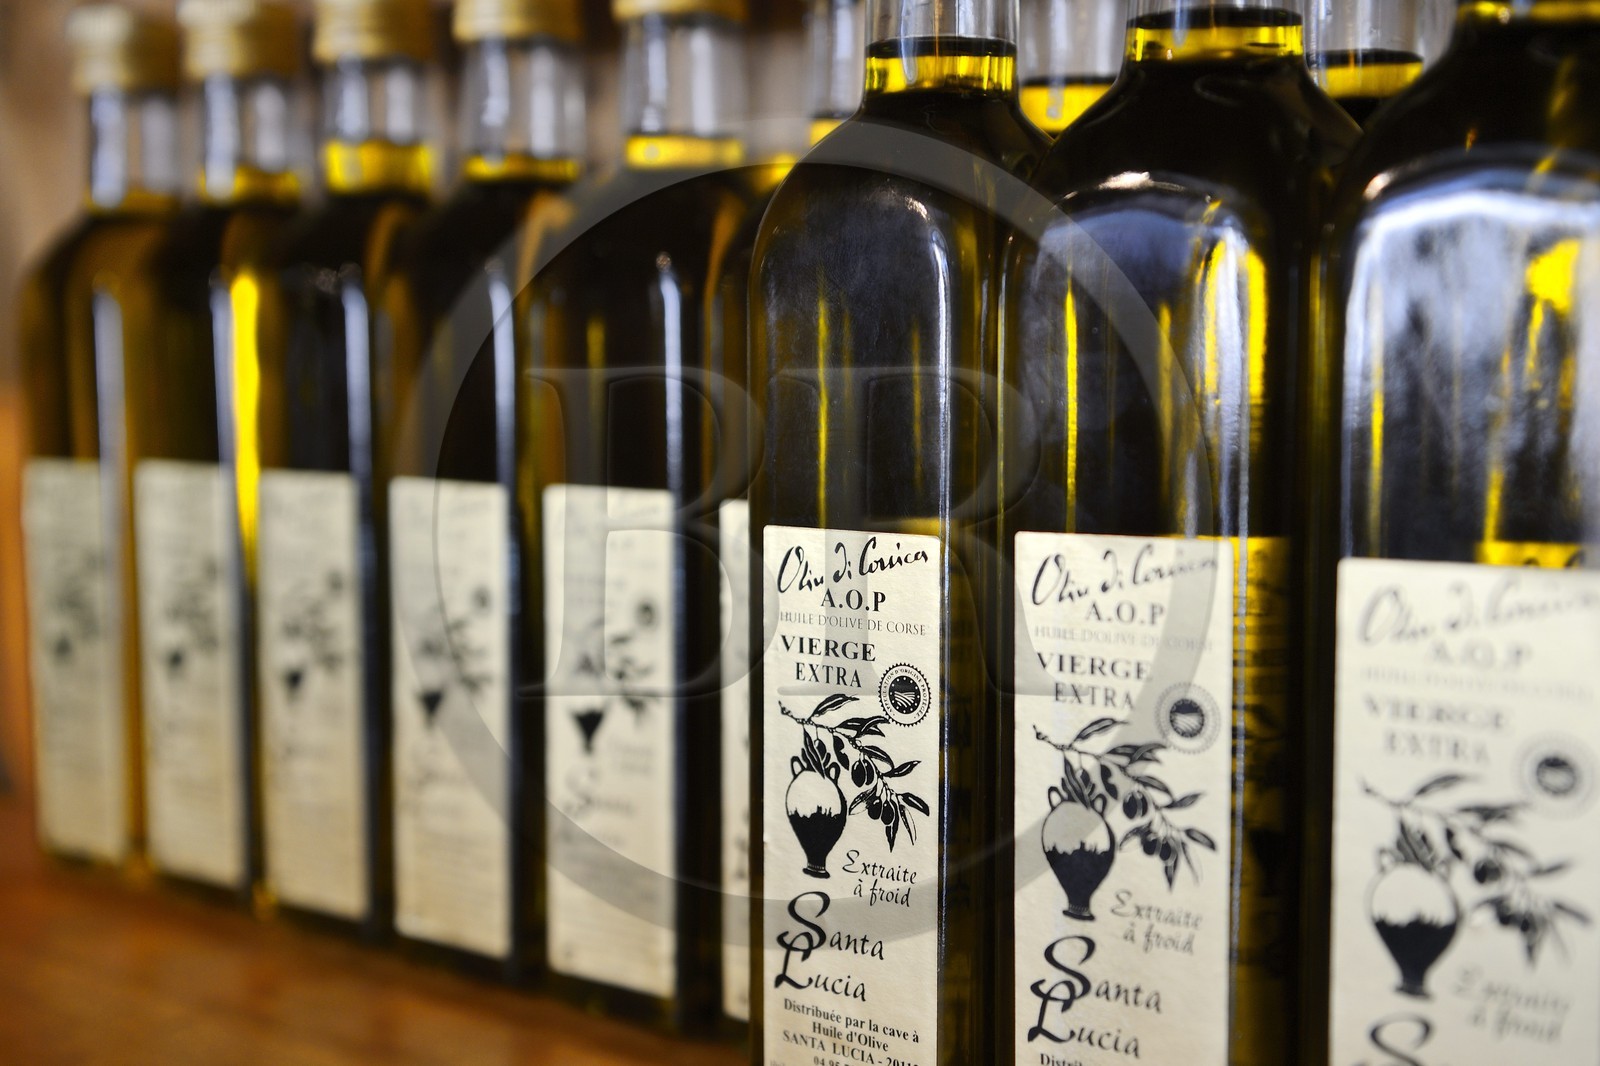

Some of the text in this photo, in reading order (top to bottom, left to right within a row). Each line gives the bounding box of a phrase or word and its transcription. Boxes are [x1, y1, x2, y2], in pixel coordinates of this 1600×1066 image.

[833, 542, 852, 583] di
[859, 536, 928, 576] Corsica
[1101, 550, 1123, 593] di
[820, 588, 886, 612] A.O.P
[1086, 600, 1165, 626] A.O.P
[780, 611, 926, 636] HUILE D'OLIVE DE CORSE
[781, 634, 876, 662] VIERGE
[795, 662, 862, 688] EXTRA
[1037, 652, 1152, 681] VIERGE
[1054, 682, 1135, 710] EXTRA
[842, 849, 917, 884] Extraite
[853, 878, 911, 907] à froid
[777, 891, 884, 960] Santa
[1110, 889, 1202, 931] Extraite
[1144, 924, 1195, 955] froid
[774, 931, 866, 1002] Lucia
[1030, 936, 1162, 1013] Santa
[784, 998, 920, 1043] Distribuée par la cave à
[1027, 980, 1140, 1058] Lucia
[783, 1030, 826, 1052] SANTA
[832, 1042, 875, 1065] LUCIA
[886, 1057, 919, 1066] 201
[812, 1021, 889, 1052] Huile d'Olive
